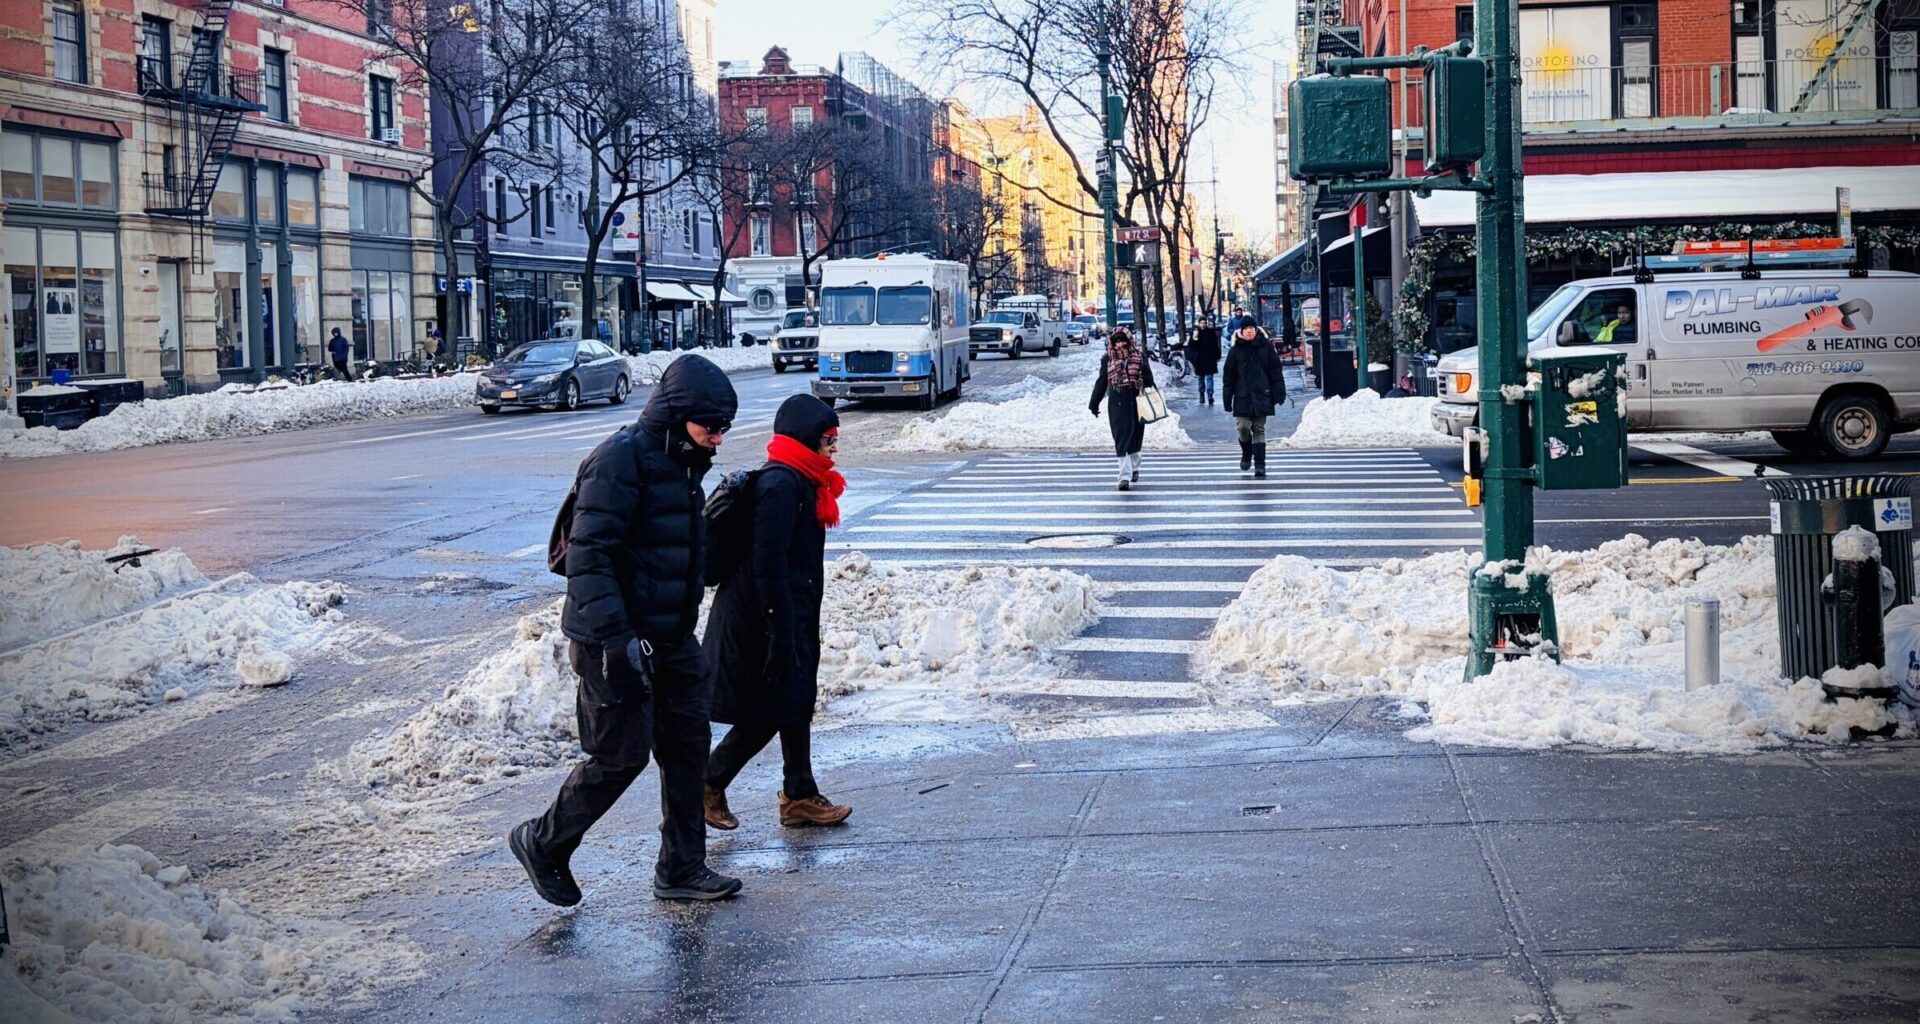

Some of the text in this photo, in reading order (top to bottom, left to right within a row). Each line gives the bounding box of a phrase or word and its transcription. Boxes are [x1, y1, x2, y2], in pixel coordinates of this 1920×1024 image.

[1523, 54, 1598, 67] ORTOFINO
[1132, 230, 1141, 239] 72
[440, 278, 466, 292] CSE
[1664, 285, 1841, 320] PAL-MAR
[1683, 320, 1762, 335] PLUMBING
[1806, 339, 1817, 351] &
[1824, 336, 1888, 351] HEATING
[1746, 360, 1864, 375] 718-366-9480
[1672, 387, 1694, 395] Plumber
